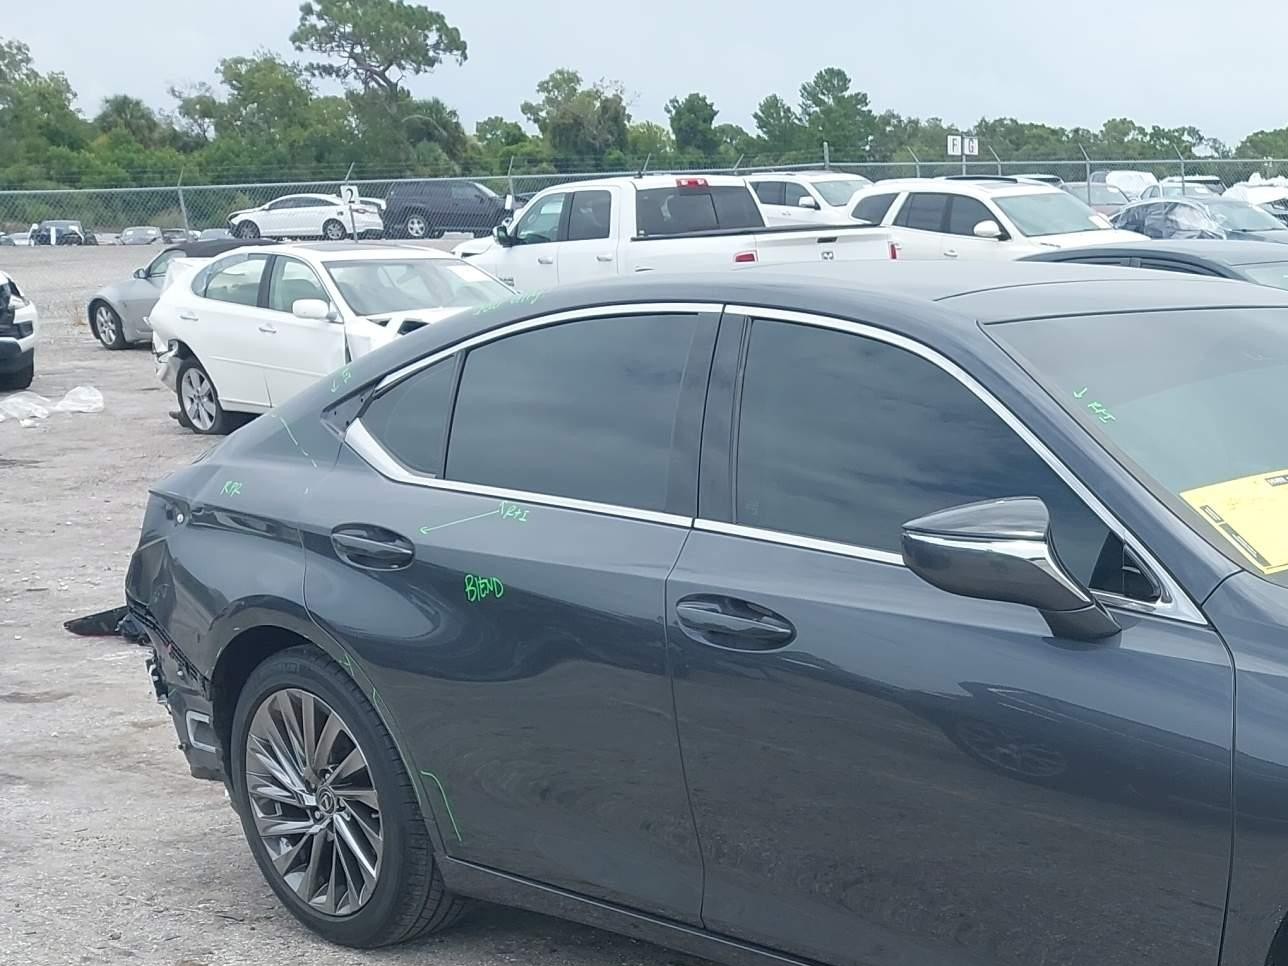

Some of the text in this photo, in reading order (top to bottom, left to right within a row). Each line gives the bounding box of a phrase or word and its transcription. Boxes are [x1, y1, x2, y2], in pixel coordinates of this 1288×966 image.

[951, 137, 958, 153] F
[968, 138, 975, 153] G
[345, 187, 356, 204] 2
